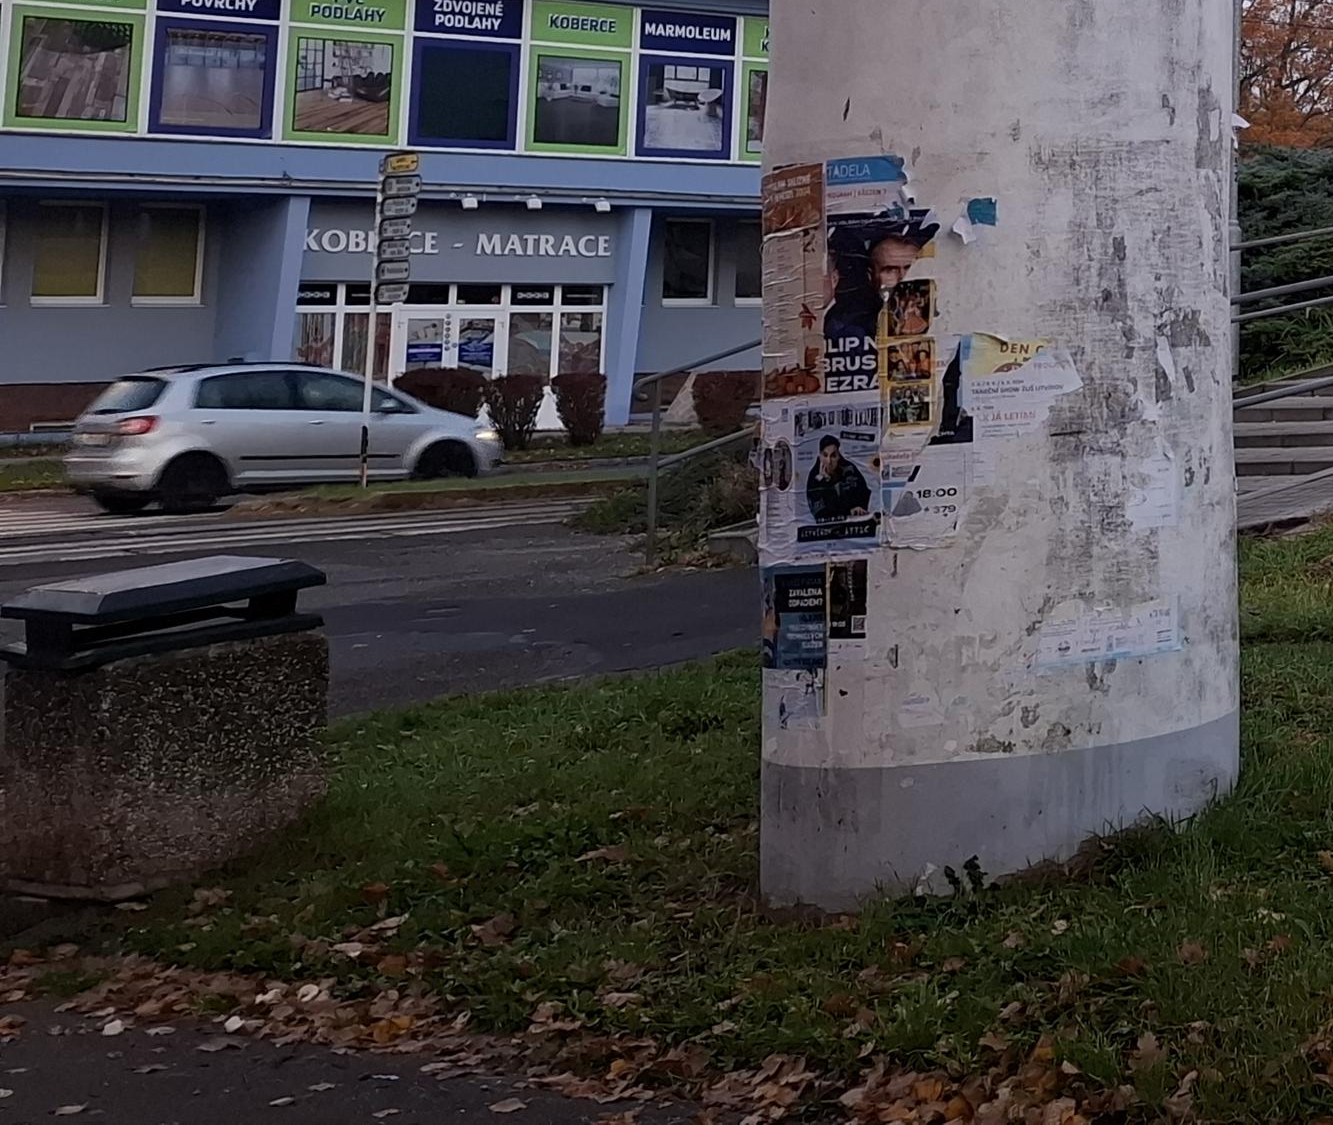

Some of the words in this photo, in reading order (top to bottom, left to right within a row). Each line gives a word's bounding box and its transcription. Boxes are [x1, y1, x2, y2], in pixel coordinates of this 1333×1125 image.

[310, 2, 386, 23] PODLAHY
[433, 0, 504, 16] ZDVOJENÉ
[435, 13, 502, 31] PODLAHY
[549, 13, 617, 34] KOBERCE
[645, 22, 731, 42] MARMOLEUM
[302, 229, 439, 254] KOBCE
[475, 234, 611, 257] MATRACE
[1000, 343, 1030, 354] DEN
[916, 487, 958, 499] 18:00
